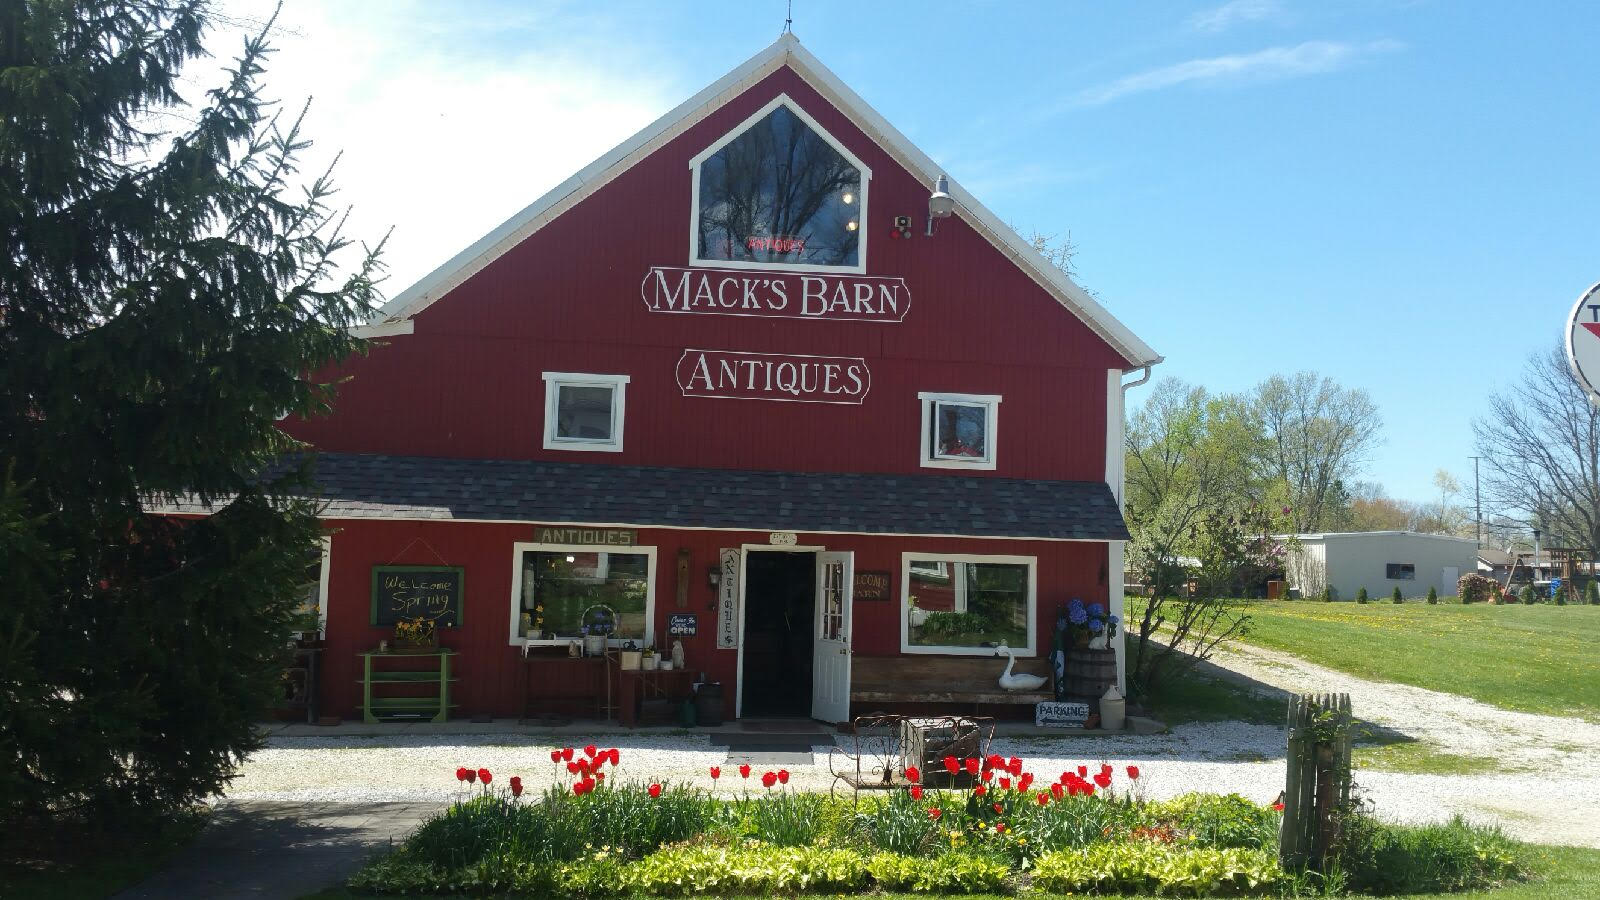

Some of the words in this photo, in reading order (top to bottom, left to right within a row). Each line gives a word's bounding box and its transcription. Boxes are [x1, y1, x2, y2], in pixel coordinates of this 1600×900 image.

[652, 269, 788, 311] MACK'S
[800, 275, 900, 317] BARN
[685, 352, 863, 396] ANTIQUES
[541, 528, 631, 545] ANTIQUES
[854, 574, 889, 591] LCOME
[853, 589, 881, 598] ARN
[670, 626, 696, 634] OPEN
[1039, 704, 1085, 717] PARKING
